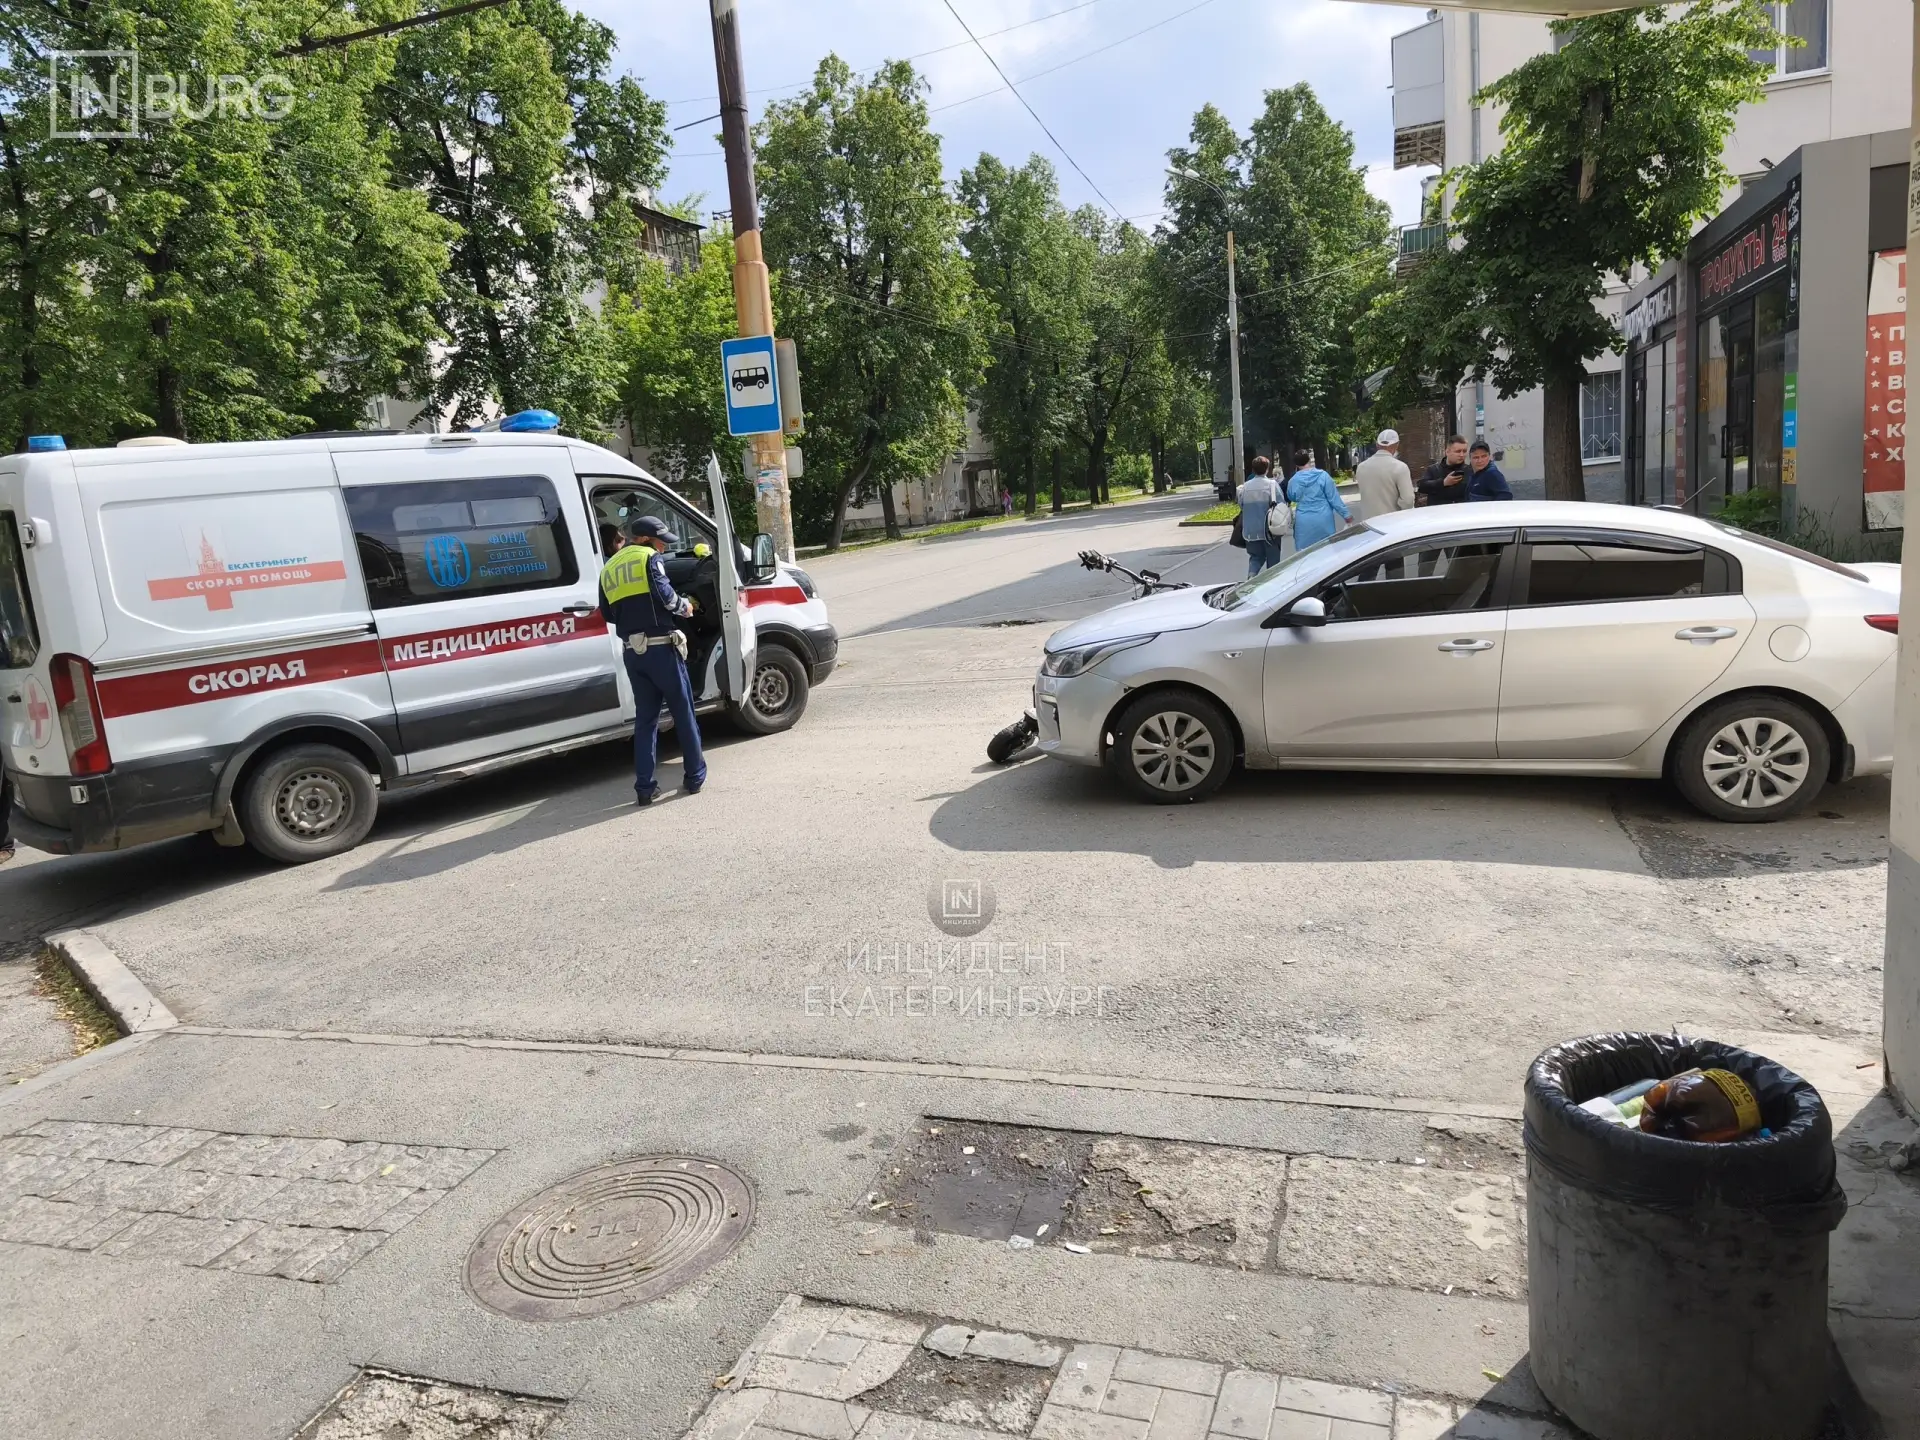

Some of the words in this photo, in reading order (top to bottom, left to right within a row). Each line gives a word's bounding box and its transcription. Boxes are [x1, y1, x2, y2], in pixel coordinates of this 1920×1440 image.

[1700, 223, 1765, 302] ПРОДУКТЫ
[1772, 207, 1787, 250] 24
[488, 531, 528, 546] ФОНД
[227, 556, 309, 571] ЕКАТЕРИНБУРГ
[479, 561, 548, 577] Екатерины
[186, 577, 244, 591] СКОРАЯ
[249, 569, 312, 584] ПОМОЩЬ
[604, 559, 644, 592] ДПС
[188, 659, 307, 695] СКОРАЯ
[393, 617, 576, 662] МЕДИЦИНСКАЯ
